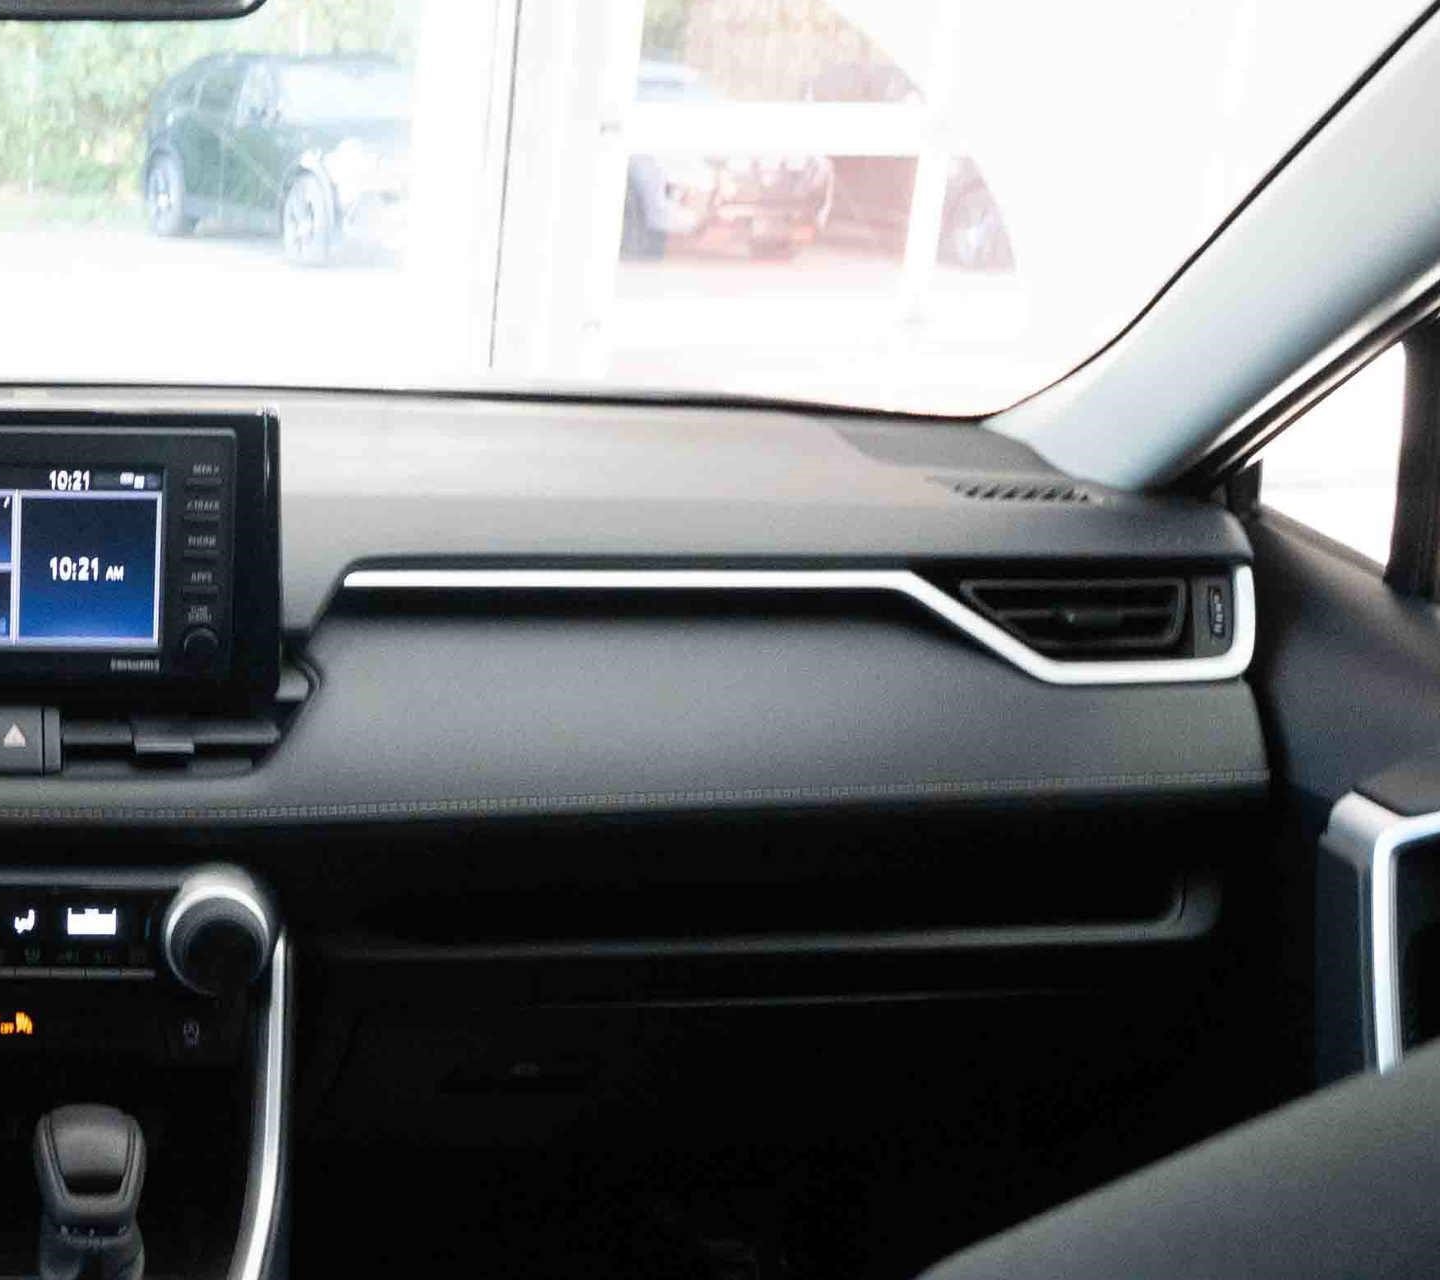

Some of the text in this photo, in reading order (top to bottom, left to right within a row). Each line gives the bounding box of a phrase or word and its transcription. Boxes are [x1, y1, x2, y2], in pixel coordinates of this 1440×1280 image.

[49, 470, 90, 491] 10:21
[49, 556, 124, 581] 10:21 AM
